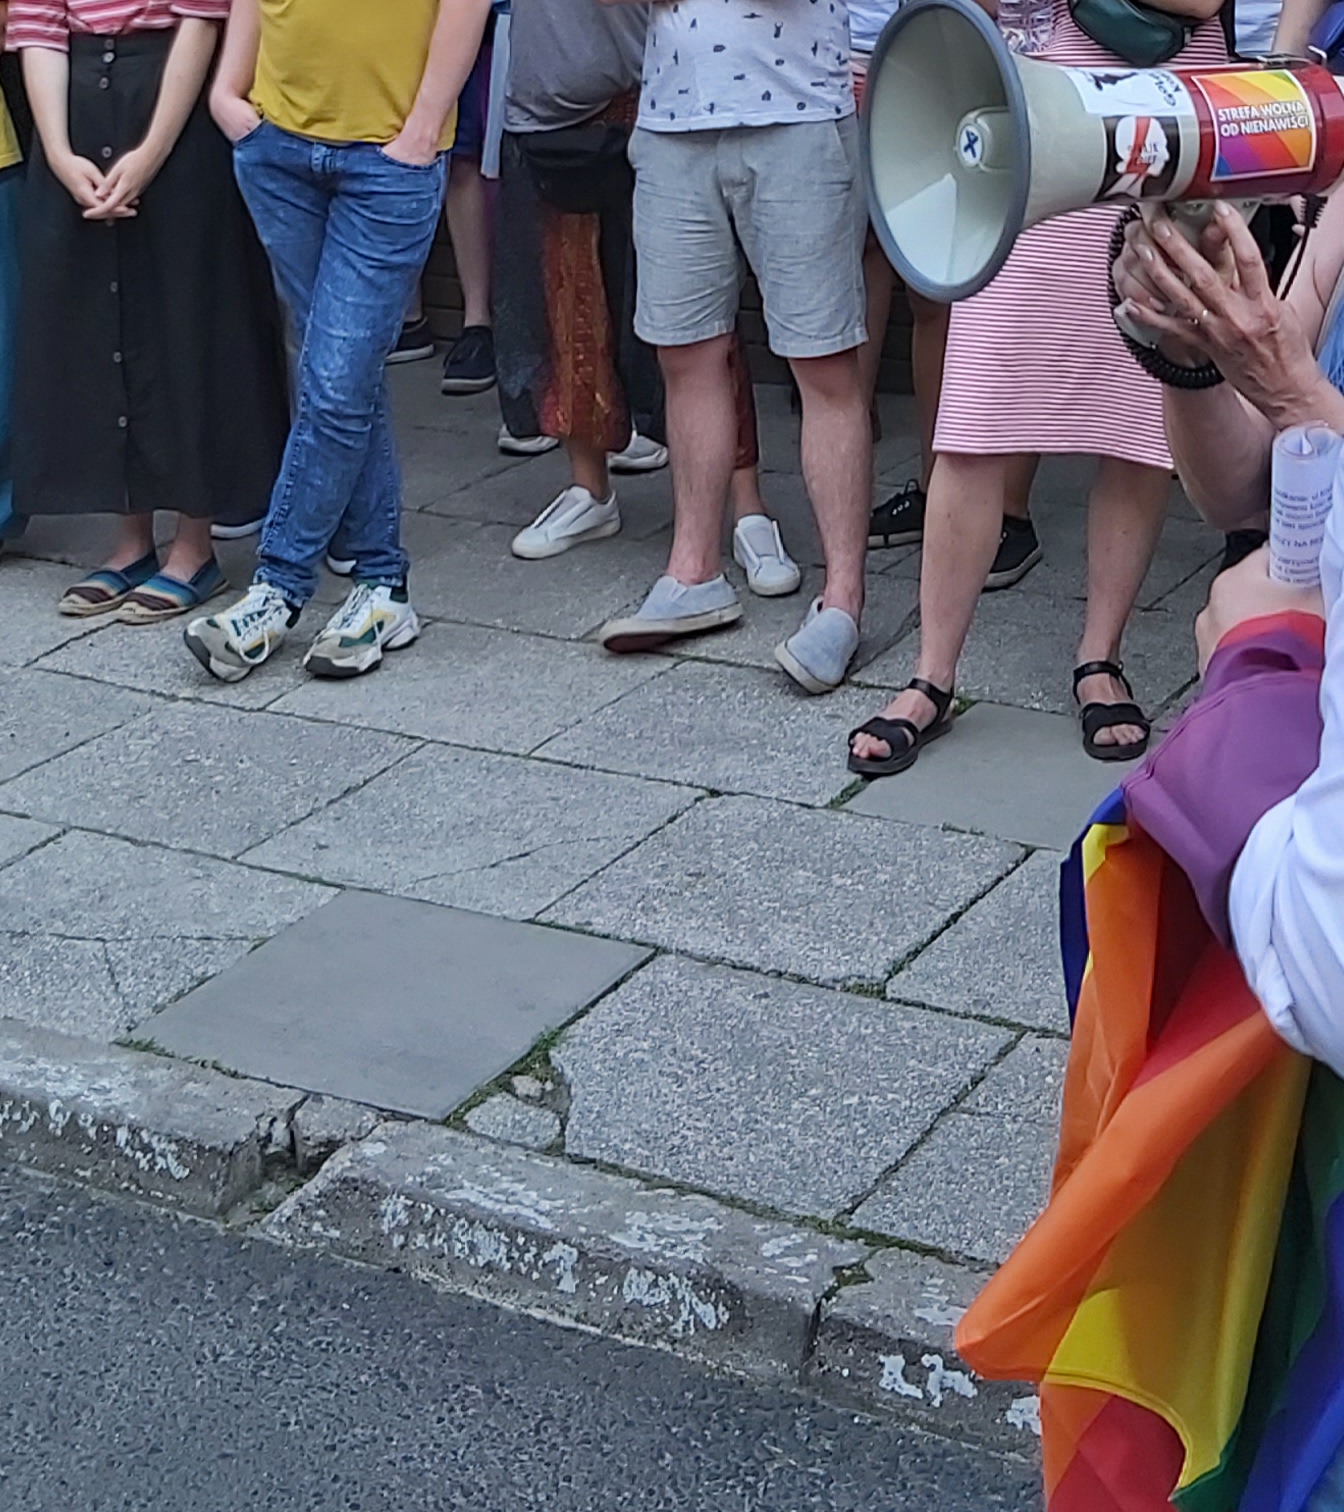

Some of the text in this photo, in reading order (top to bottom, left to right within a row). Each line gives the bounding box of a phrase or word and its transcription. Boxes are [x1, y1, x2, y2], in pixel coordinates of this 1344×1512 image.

[1218, 100, 1307, 122] STREFA WOLNA
[1220, 115, 1309, 137] OD NIENAWIŚCI
